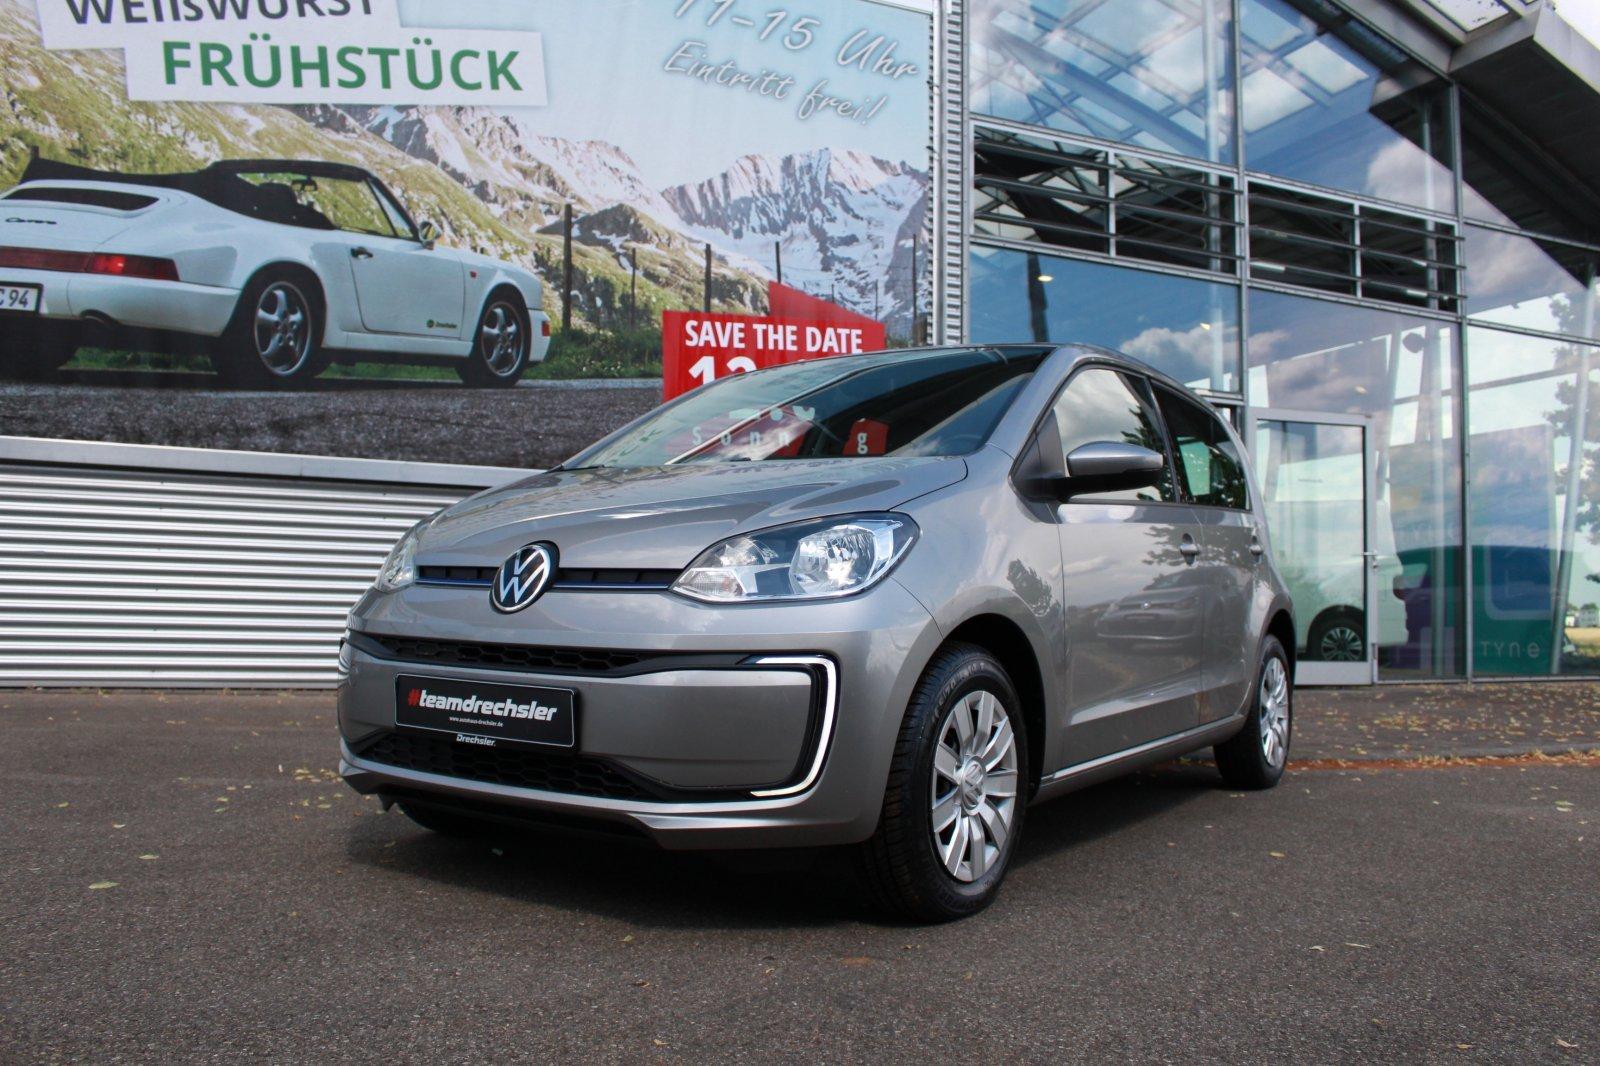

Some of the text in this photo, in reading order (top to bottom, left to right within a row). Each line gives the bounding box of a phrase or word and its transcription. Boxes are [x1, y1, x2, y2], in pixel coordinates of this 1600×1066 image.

[162, 32, 523, 91] FRÜHSTÜCK
[837, 29, 919, 79] Uhr
[663, 40, 888, 125] Eintritt frei!
[685, 319, 863, 353] SAVE THE DATE
[408, 688, 557, 721] #teamdrechsler
